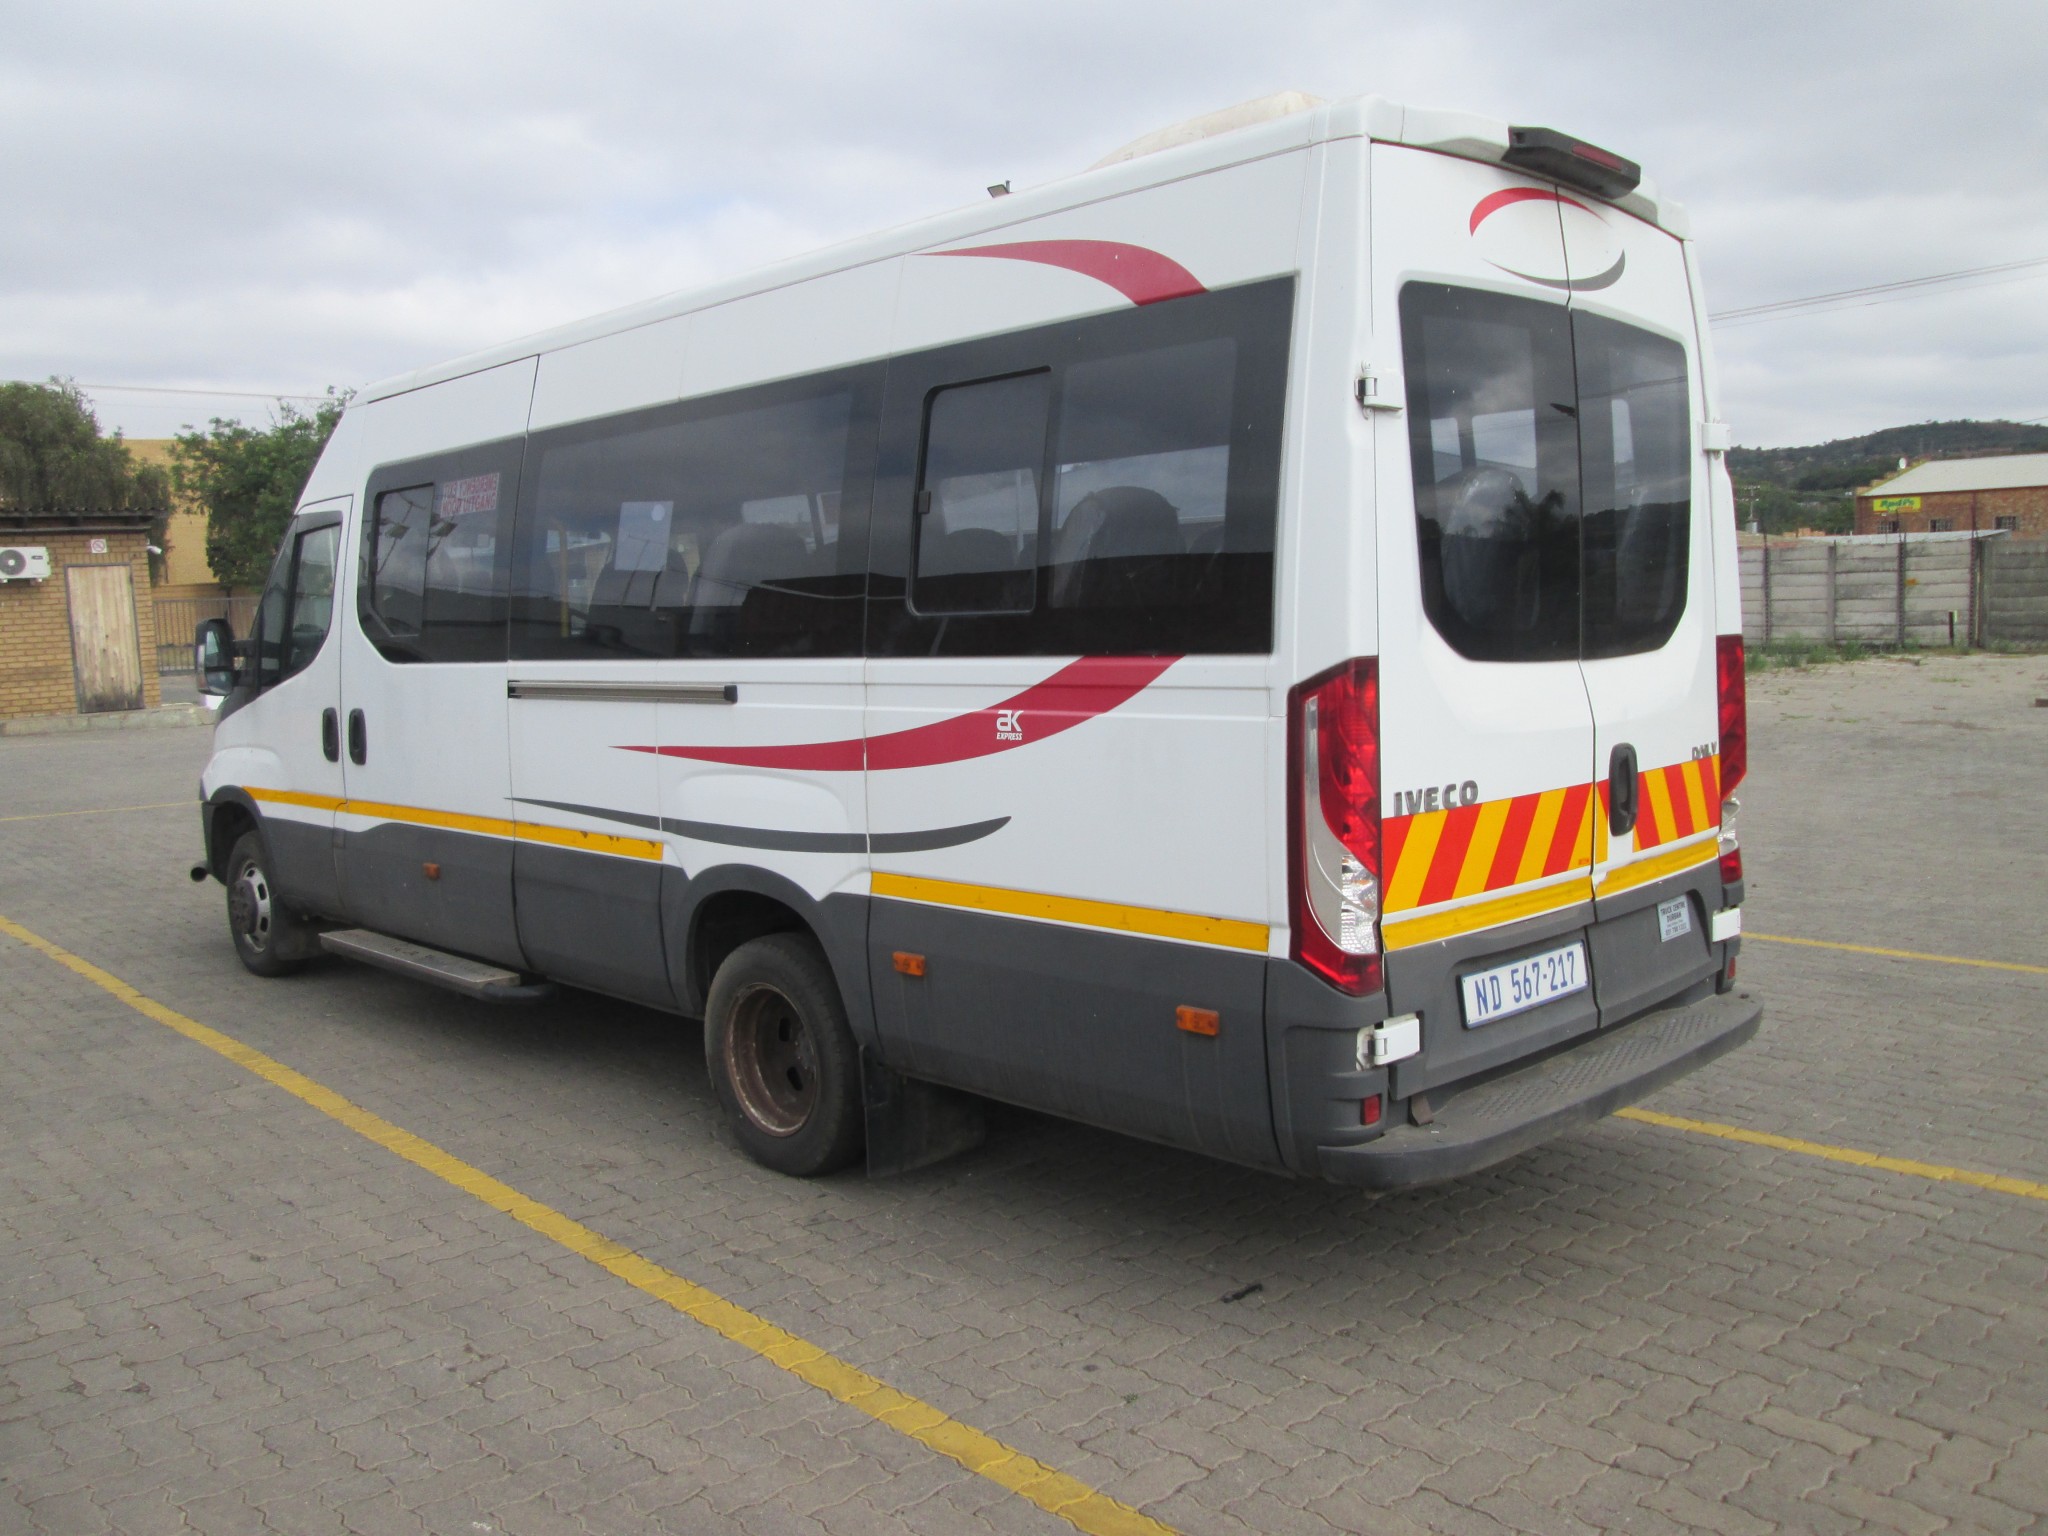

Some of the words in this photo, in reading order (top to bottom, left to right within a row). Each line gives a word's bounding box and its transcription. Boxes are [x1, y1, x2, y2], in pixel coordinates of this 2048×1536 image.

[996, 732, 1022, 740] EXPRESS
[1393, 780, 1479, 817] IVECO
[1667, 911, 1681, 922] DURBAN
[1475, 975, 1502, 1017] ND
[1510, 951, 1575, 1004] 567-217
